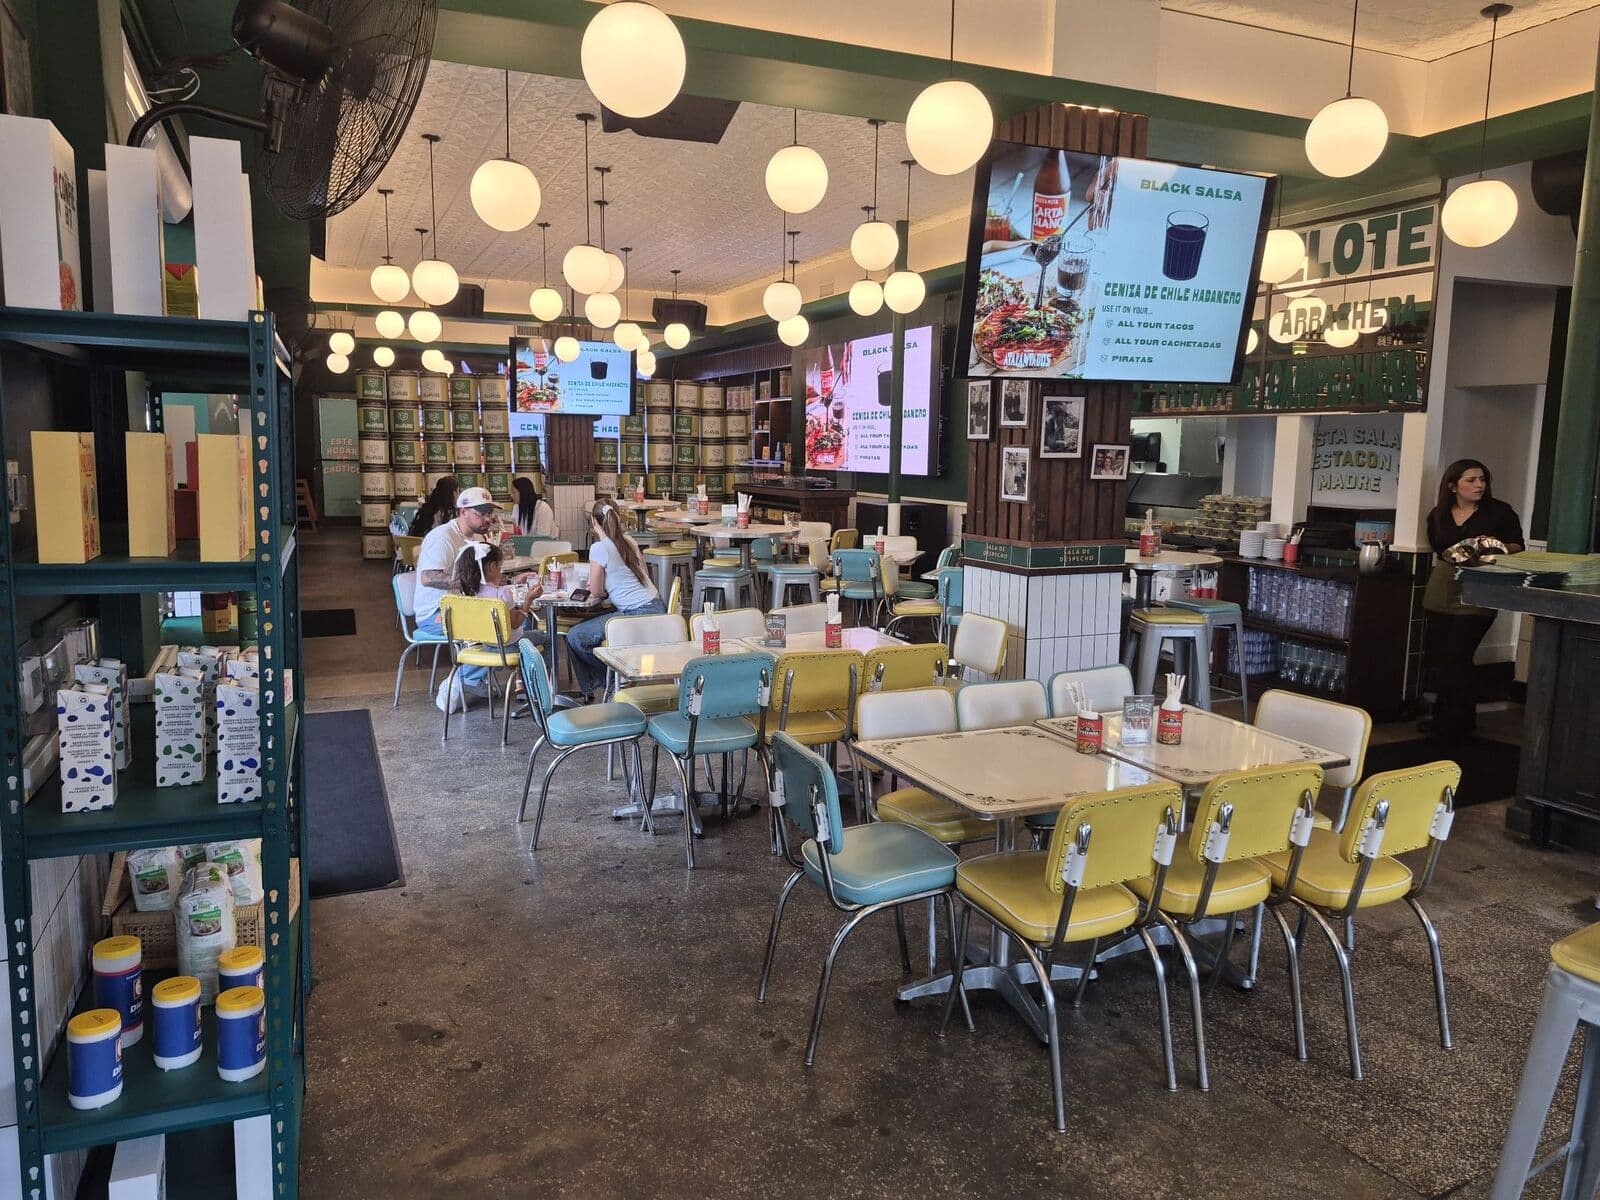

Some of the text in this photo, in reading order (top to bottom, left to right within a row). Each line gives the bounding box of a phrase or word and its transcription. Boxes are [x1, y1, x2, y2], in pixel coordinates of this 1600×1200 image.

[1140, 179, 1242, 201] BLACK SALSA
[1302, 206, 1434, 281] LOTE
[1104, 282, 1241, 304] CENIZA DE CHILE HABANERO
[1102, 304, 1113, 313] USE
[1115, 305, 1121, 313] IT
[1117, 320, 1194, 331] ALL YOUR TACOS
[1114, 337, 1222, 349] ALL YOUR CACHETADAS
[863, 346, 888, 356] BLACK
[1112, 355, 1154, 364] PIRATAS
[1318, 472, 1381, 493] MADRE
